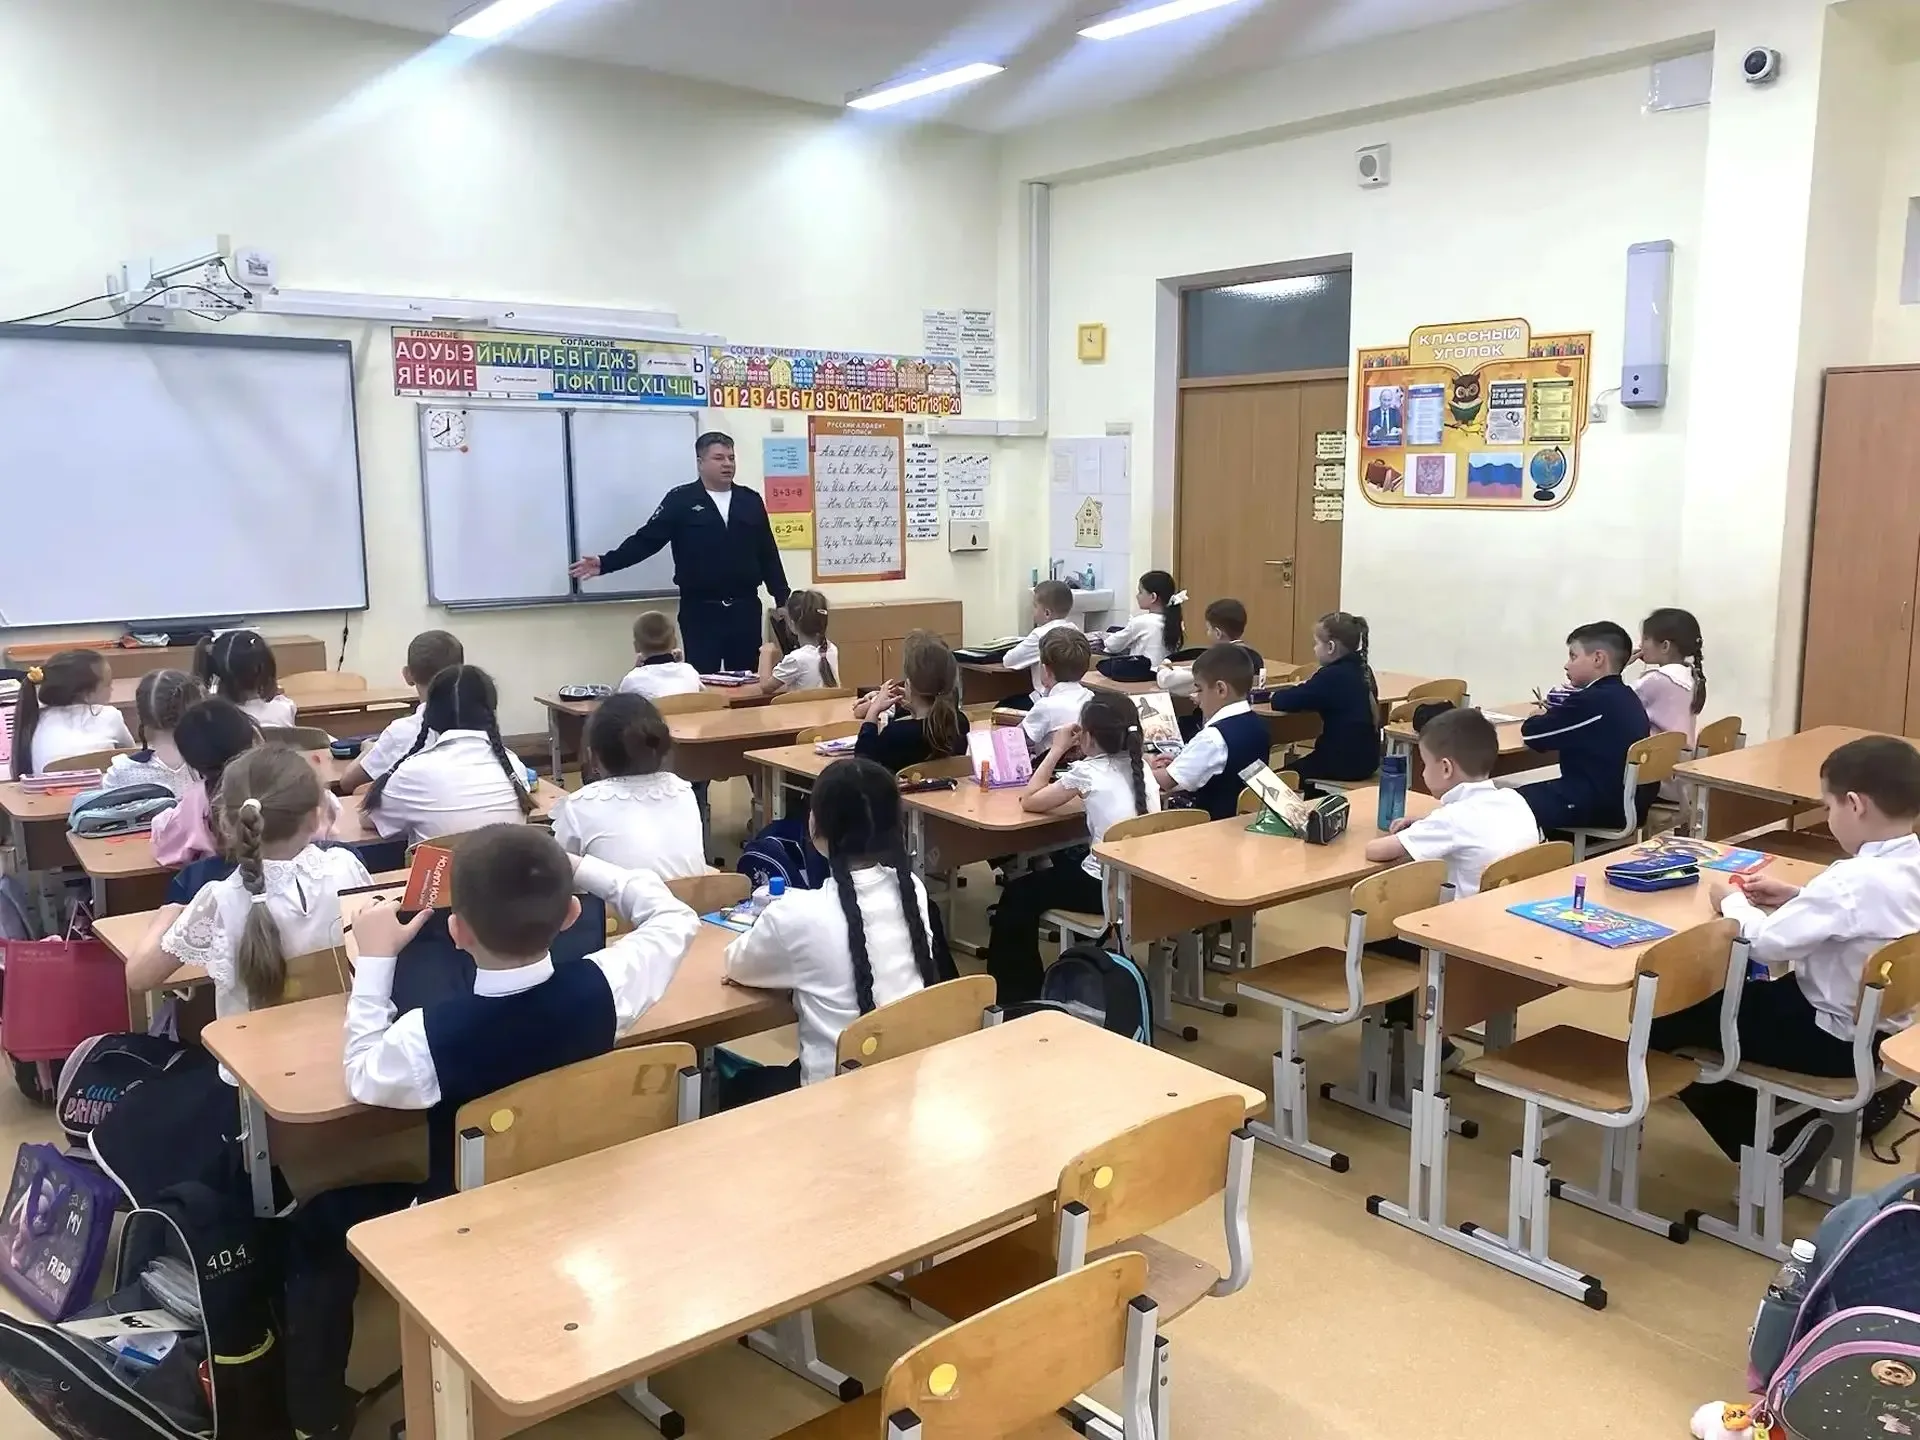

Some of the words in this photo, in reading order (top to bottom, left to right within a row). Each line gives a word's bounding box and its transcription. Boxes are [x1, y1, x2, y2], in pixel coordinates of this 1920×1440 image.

[410, 330, 459, 338] ГЛАСНЫЕ
[561, 337, 615, 347] СОГЛАСНЫЕ
[1419, 327, 1520, 345] КЛАССНЫЙ
[730, 346, 764, 355] СОСТАВ
[771, 348, 800, 357] ЧИСЕЛ
[806, 350, 816, 358] ОТ
[826, 352, 839, 360] ДО
[1434, 344, 1504, 359] УГОЛОК
[714, 388, 722, 405] 0
[728, 389, 734, 405] 1
[740, 389, 749, 406] 2
[754, 390, 761, 406] 3
[767, 390, 775, 406] 4
[780, 391, 788, 407] 5
[792, 391, 800, 408] 6
[804, 392, 812, 408] 7
[816, 392, 824, 408] 8
[828, 393, 835, 409] 9
[838, 394, 849, 409] 10
[850, 394, 859, 410] 11
[862, 394, 872, 410] 12
[873, 395, 883, 411] 13
[884, 396, 894, 411] 14
[896, 396, 906, 412] 15
[906, 396, 916, 412] 16
[918, 396, 928, 411] 17
[929, 397, 939, 412] 18
[940, 397, 949, 412] 19
[950, 398, 960, 413] 20
[432, 855, 448, 886] КАРТОН
[66, 1210, 82, 1236] MY
[206, 1244, 246, 1270] 404
